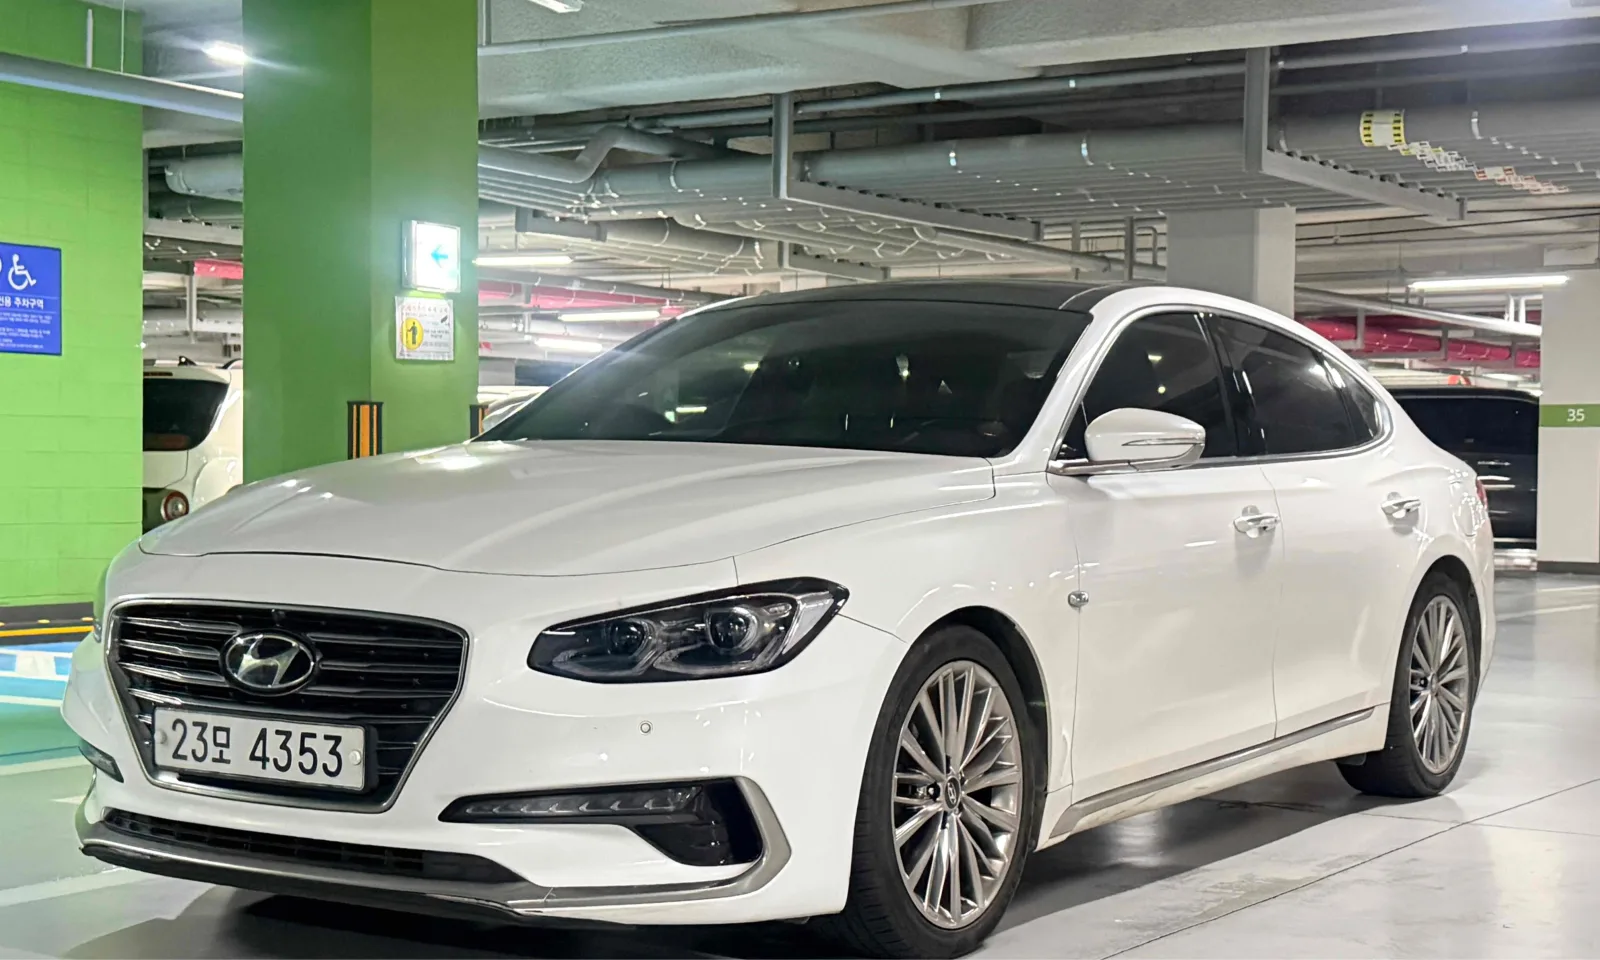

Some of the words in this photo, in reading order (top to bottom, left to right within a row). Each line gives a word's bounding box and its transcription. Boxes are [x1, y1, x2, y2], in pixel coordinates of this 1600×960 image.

[14, 296, 44, 310] 주차구역
[1567, 408, 1585, 422] 35
[172, 718, 231, 765] 23모
[249, 727, 343, 778] 4353
